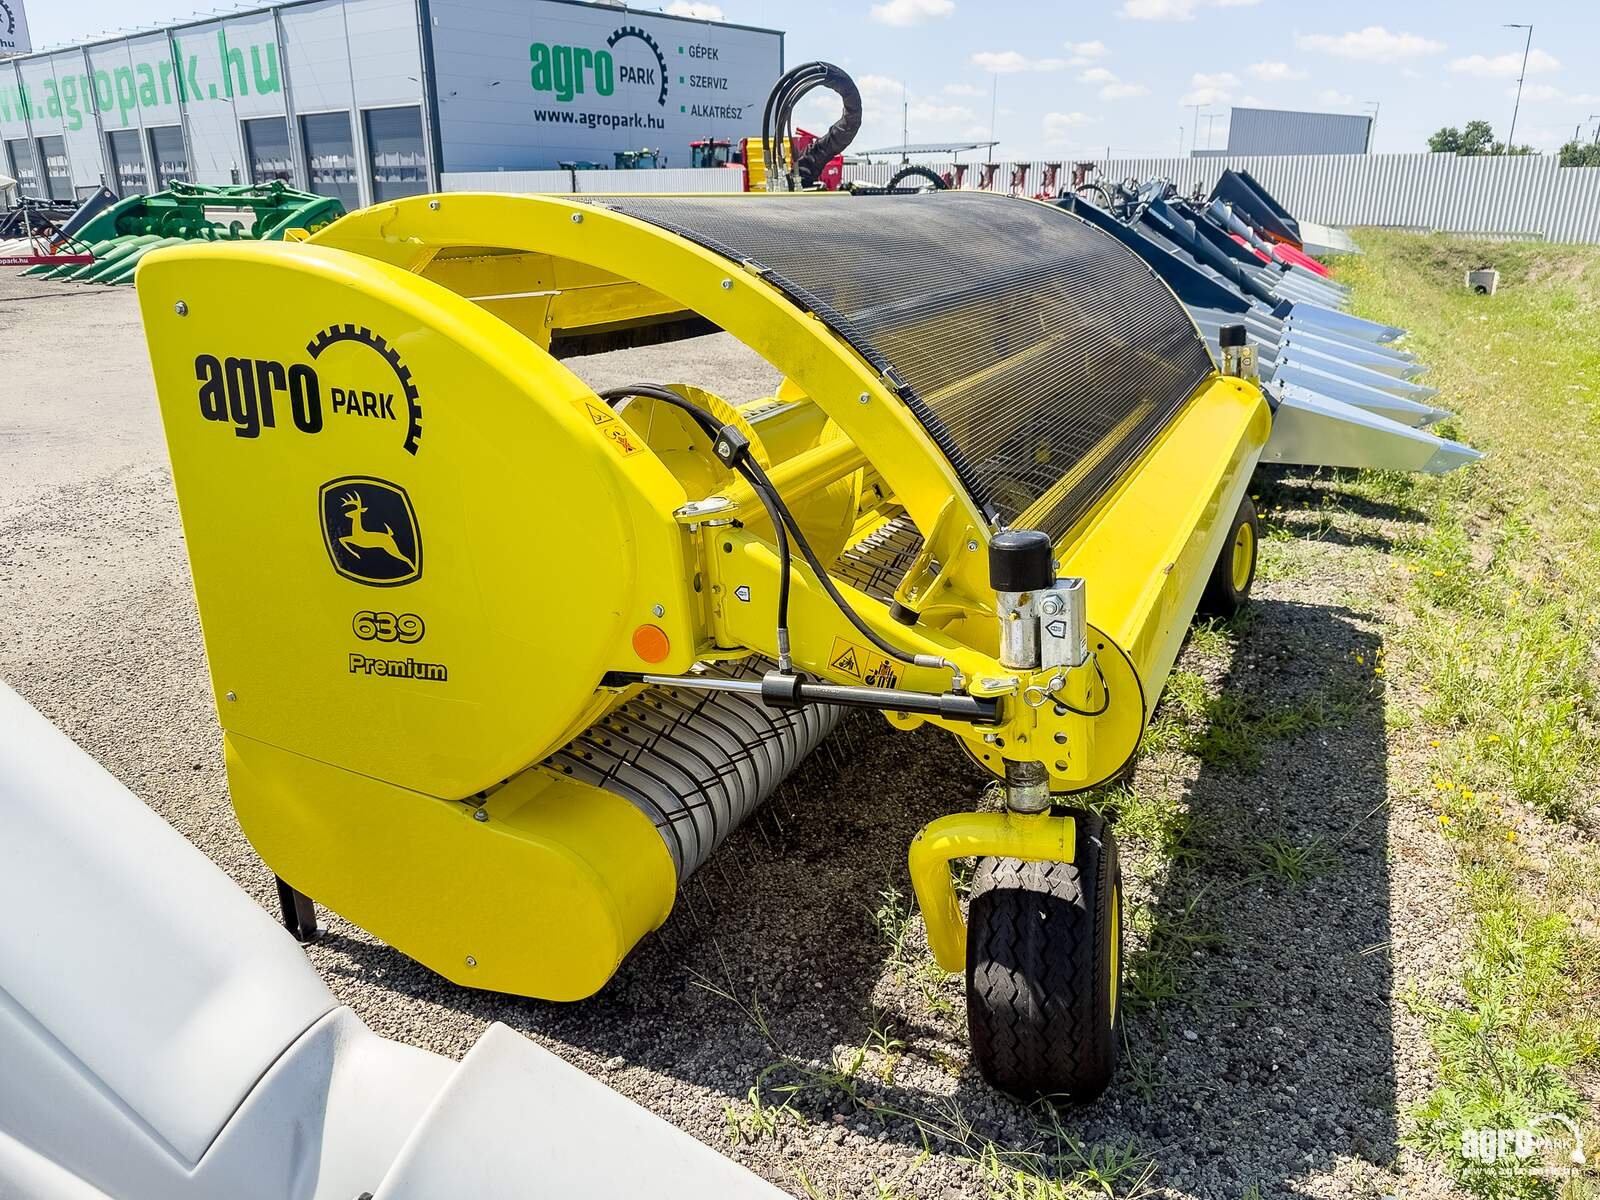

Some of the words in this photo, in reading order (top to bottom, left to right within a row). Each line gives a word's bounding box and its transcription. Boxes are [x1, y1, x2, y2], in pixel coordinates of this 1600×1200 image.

[688, 44, 719, 61] GÉPEK
[530, 42, 614, 102] agro
[619, 65, 655, 86] PARK
[689, 75, 728, 90] SZERVIZ
[534, 109, 665, 130] www.agropark.hu
[690, 104, 742, 120] ALKATRÉSZ
[194, 354, 323, 438] agro
[331, 387, 397, 420] PARK
[352, 610, 425, 644] 639
[348, 653, 448, 682] Premium
